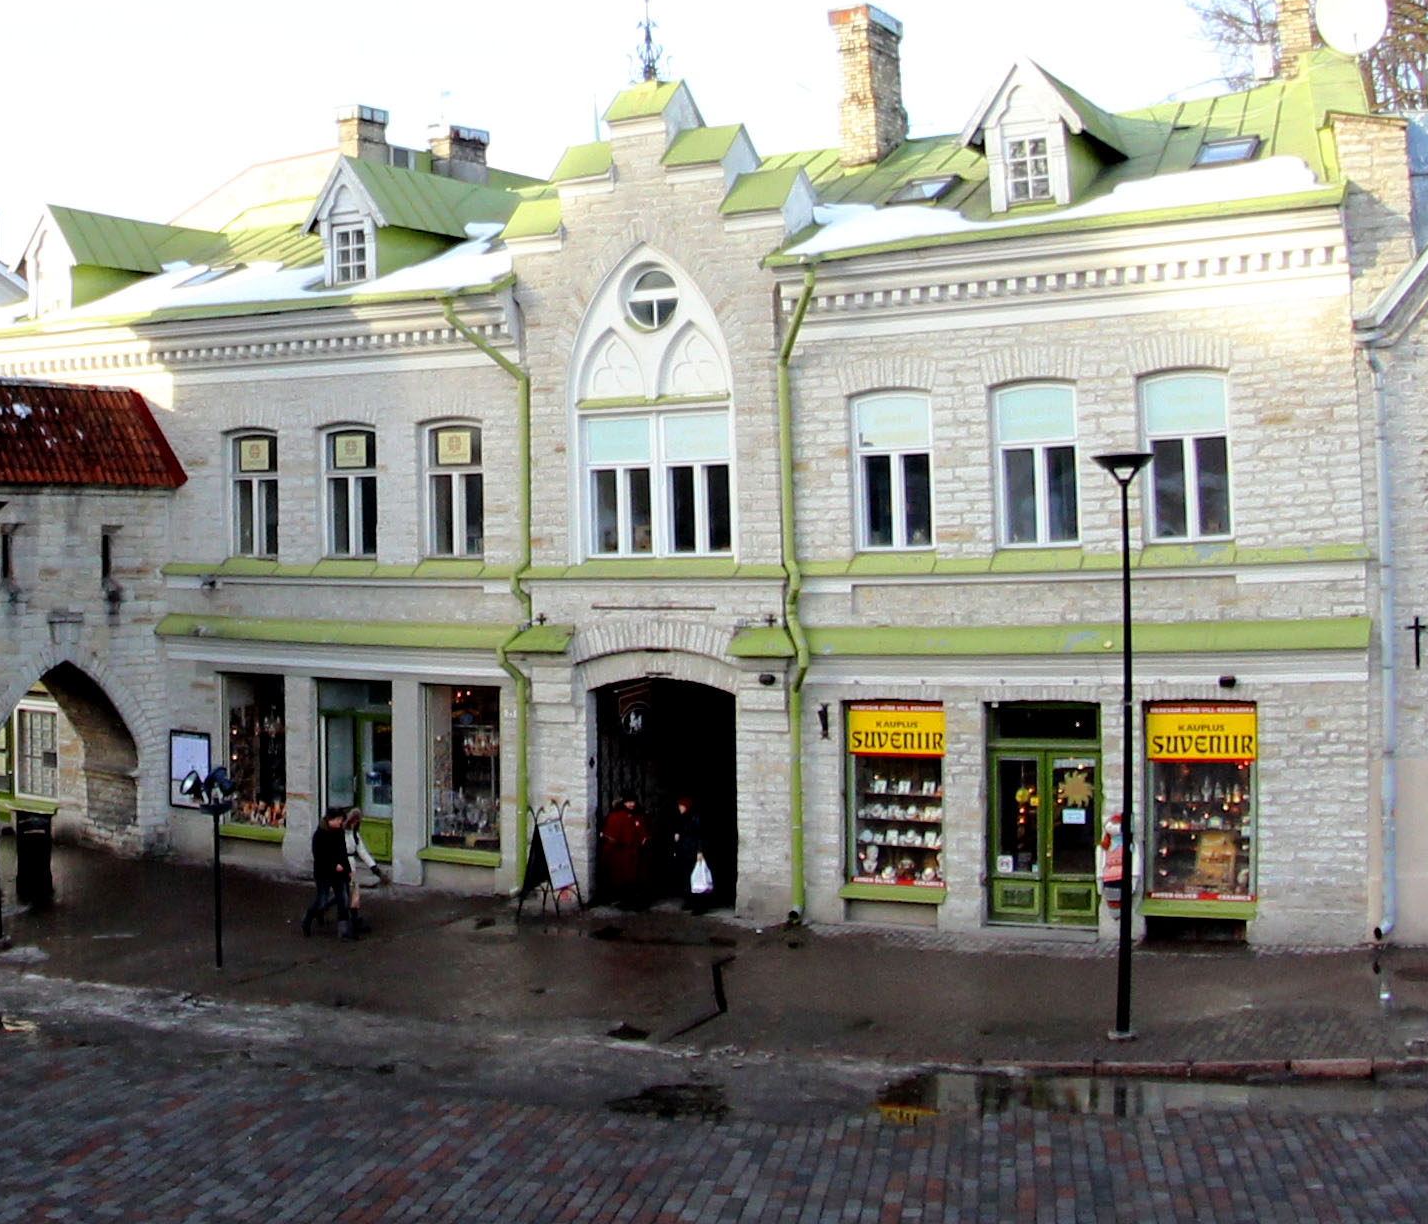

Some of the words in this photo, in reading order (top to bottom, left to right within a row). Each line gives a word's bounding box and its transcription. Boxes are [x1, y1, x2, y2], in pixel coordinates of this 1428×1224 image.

[1178, 724, 1225, 732] KAUPLUS
[852, 731, 944, 750] SUVENIIR
[1152, 735, 1253, 754] SUVENIIR
